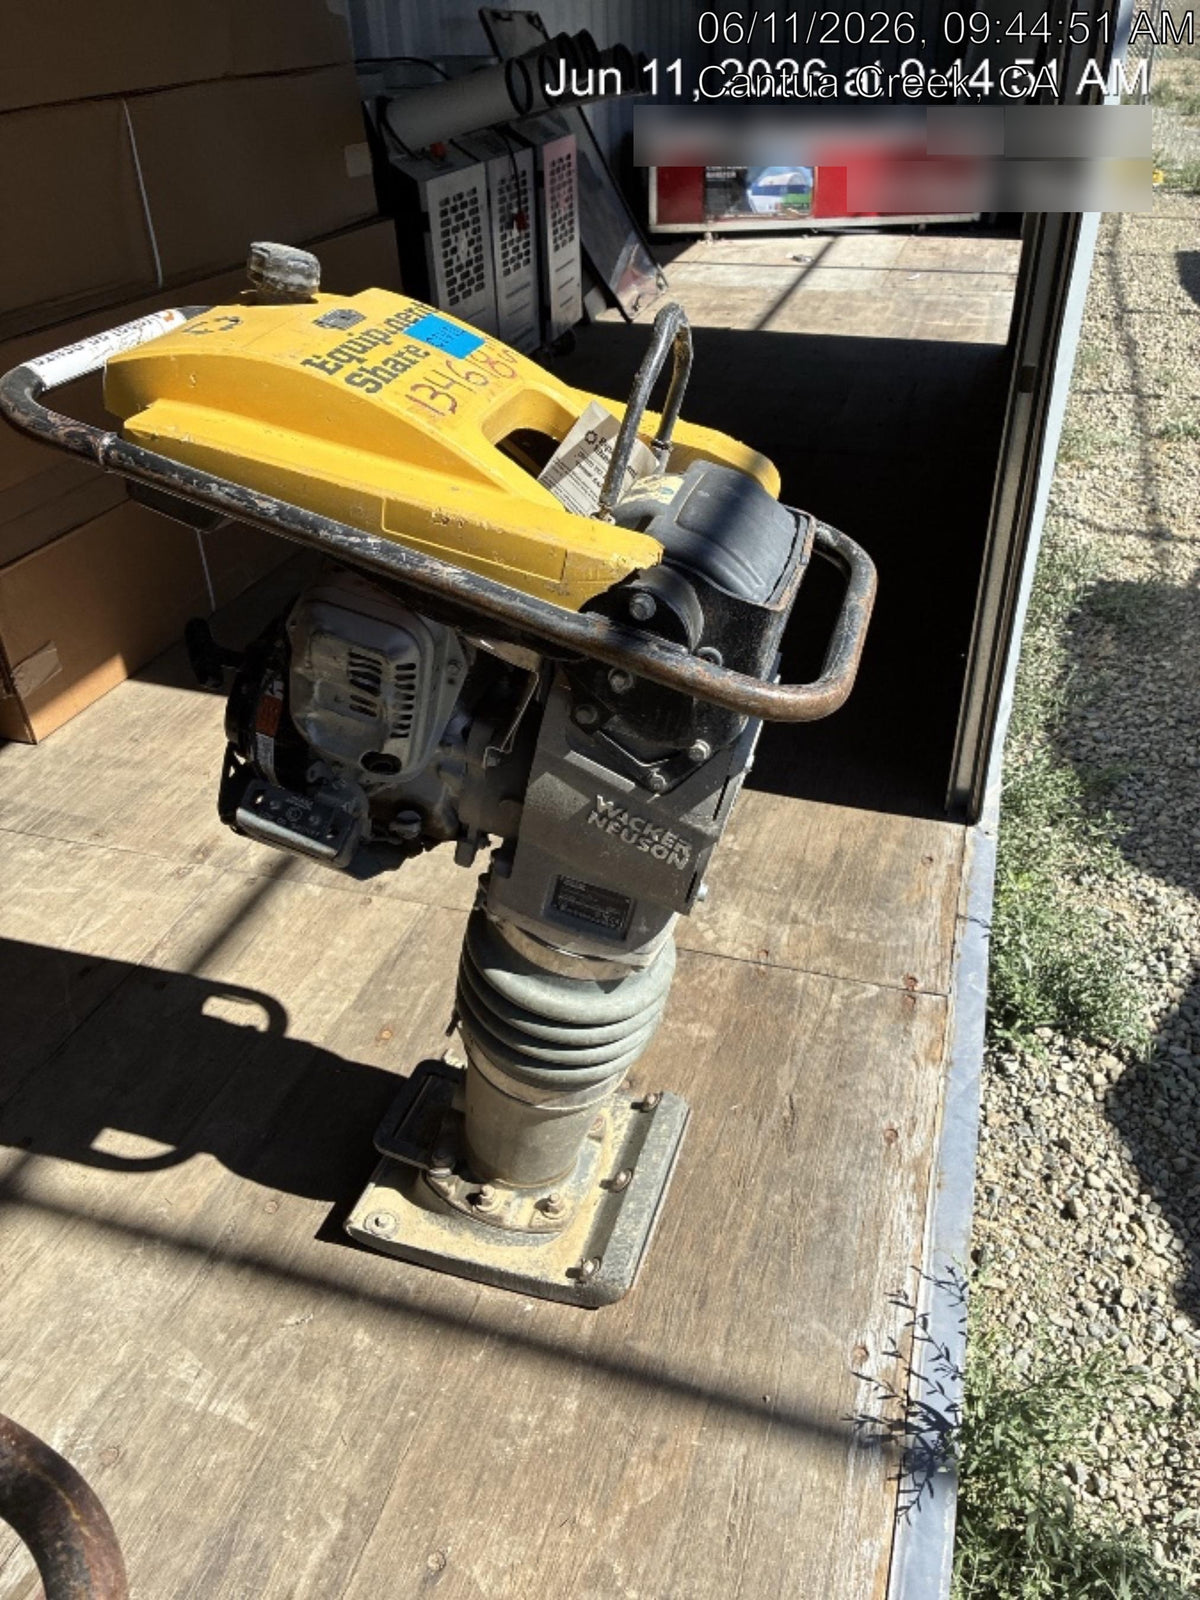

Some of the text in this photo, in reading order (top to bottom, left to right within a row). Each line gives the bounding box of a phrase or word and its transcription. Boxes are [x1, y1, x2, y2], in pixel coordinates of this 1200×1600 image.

[345, 343, 431, 394] Share
[588, 810, 691, 870] NEUSON
[596, 794, 693, 855] WACKER
